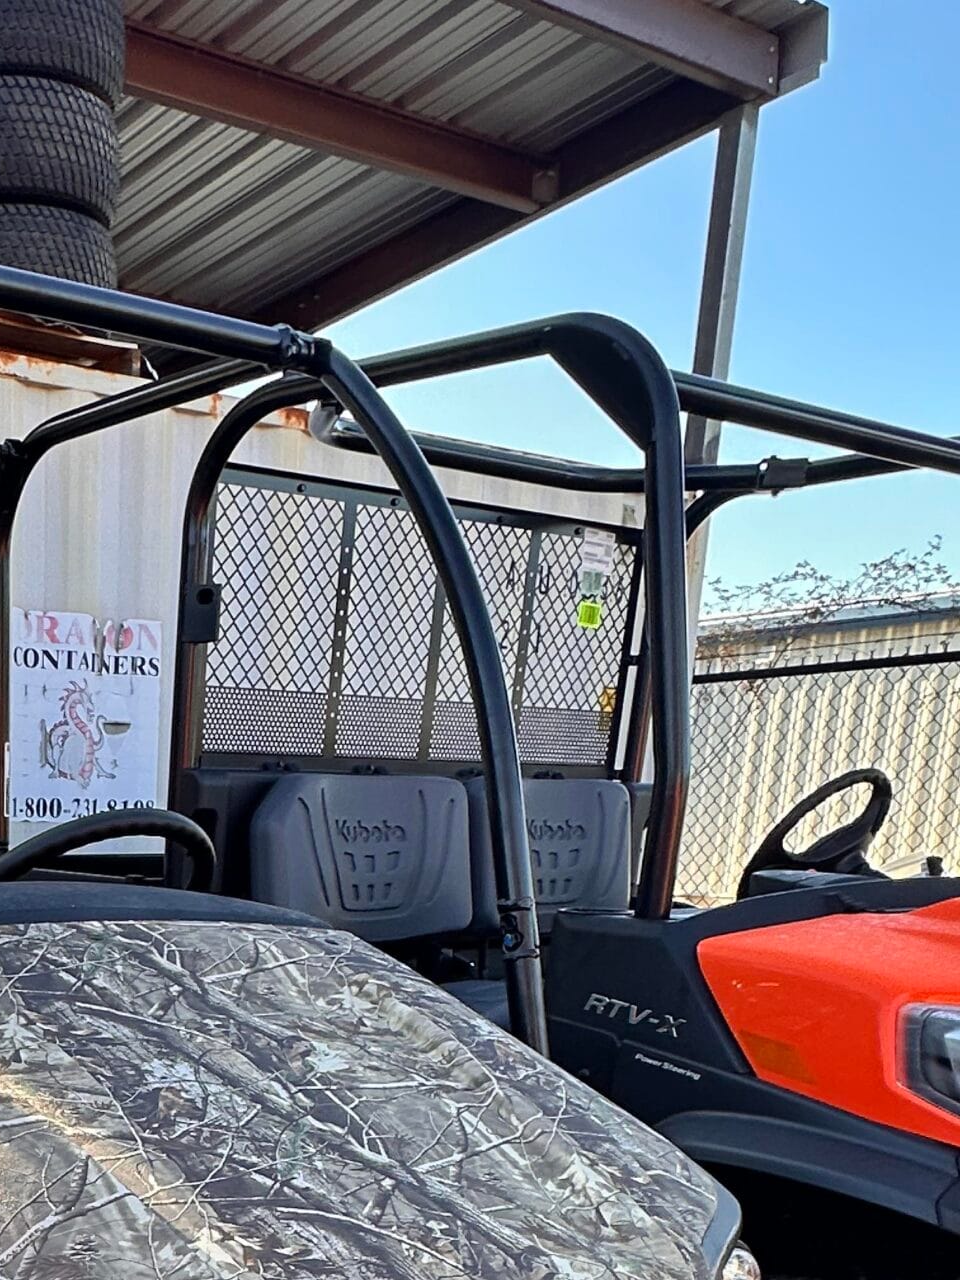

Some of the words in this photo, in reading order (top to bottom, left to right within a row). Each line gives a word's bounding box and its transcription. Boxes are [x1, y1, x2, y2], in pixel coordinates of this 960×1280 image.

[12, 615, 159, 652] RAON
[13, 646, 160, 677] CONTAINERS
[335, 818, 406, 843] Kubota
[583, 993, 687, 1038] RTV-X
[634, 1052, 662, 1067] Power
[661, 1061, 702, 1081] Steering
